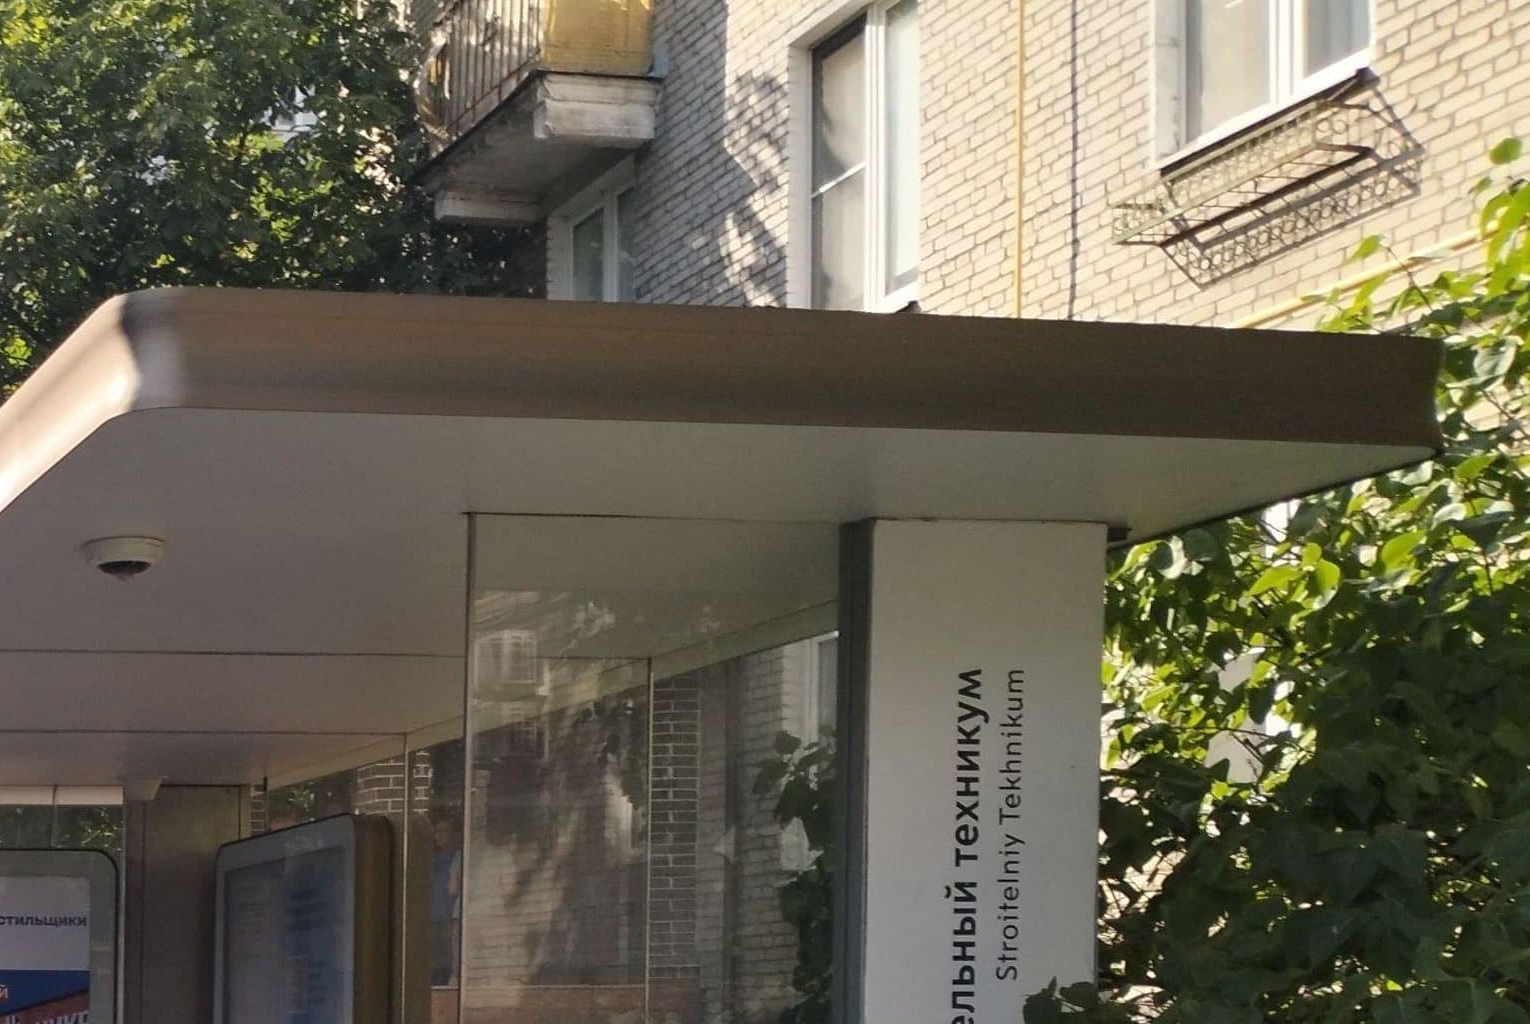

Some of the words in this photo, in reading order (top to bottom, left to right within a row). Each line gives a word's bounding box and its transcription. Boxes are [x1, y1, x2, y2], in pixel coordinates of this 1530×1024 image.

[956, 668, 989, 868] техникум
[998, 669, 1024, 827] Tekhnikum
[996, 834, 1026, 981] Stroitelniy
